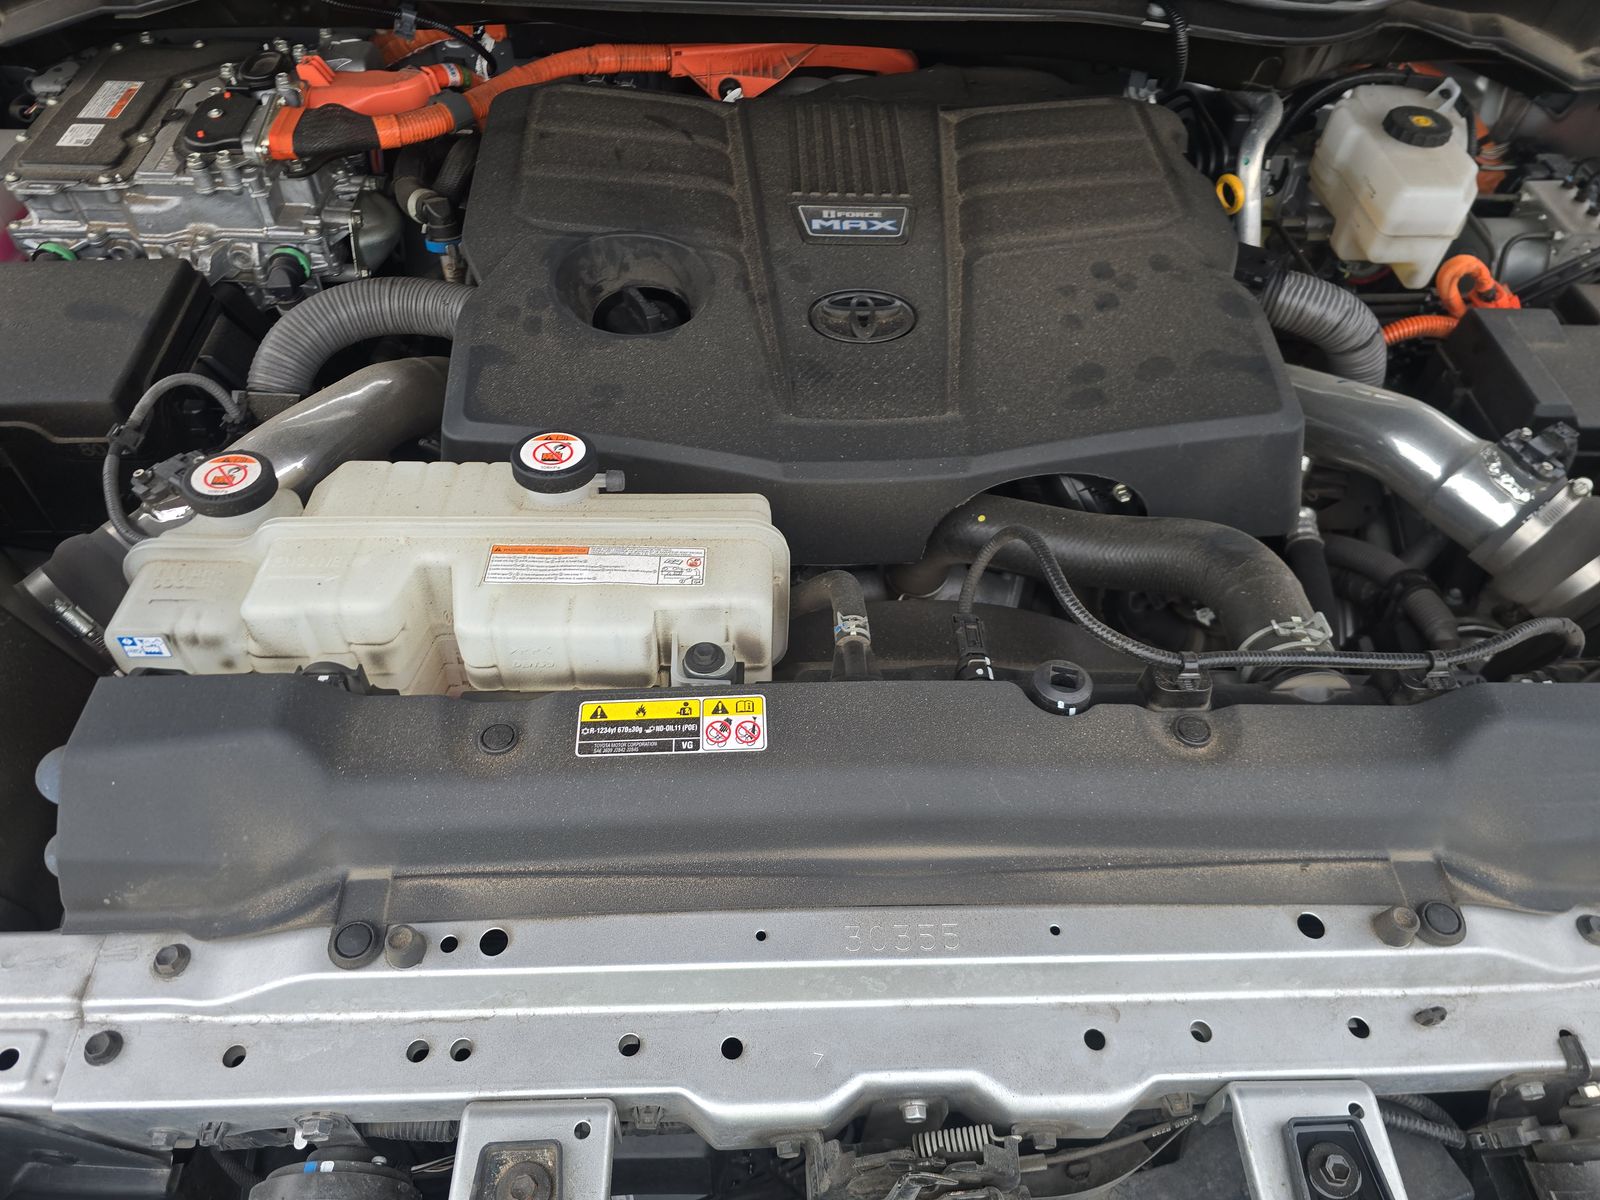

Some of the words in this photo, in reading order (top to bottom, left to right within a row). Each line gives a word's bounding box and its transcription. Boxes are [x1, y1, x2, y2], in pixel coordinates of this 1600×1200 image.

[811, 219, 897, 230] MAX
[589, 726, 616, 734] R-1234yf
[681, 741, 693, 749] VG
[844, 923, 960, 952] 30355
